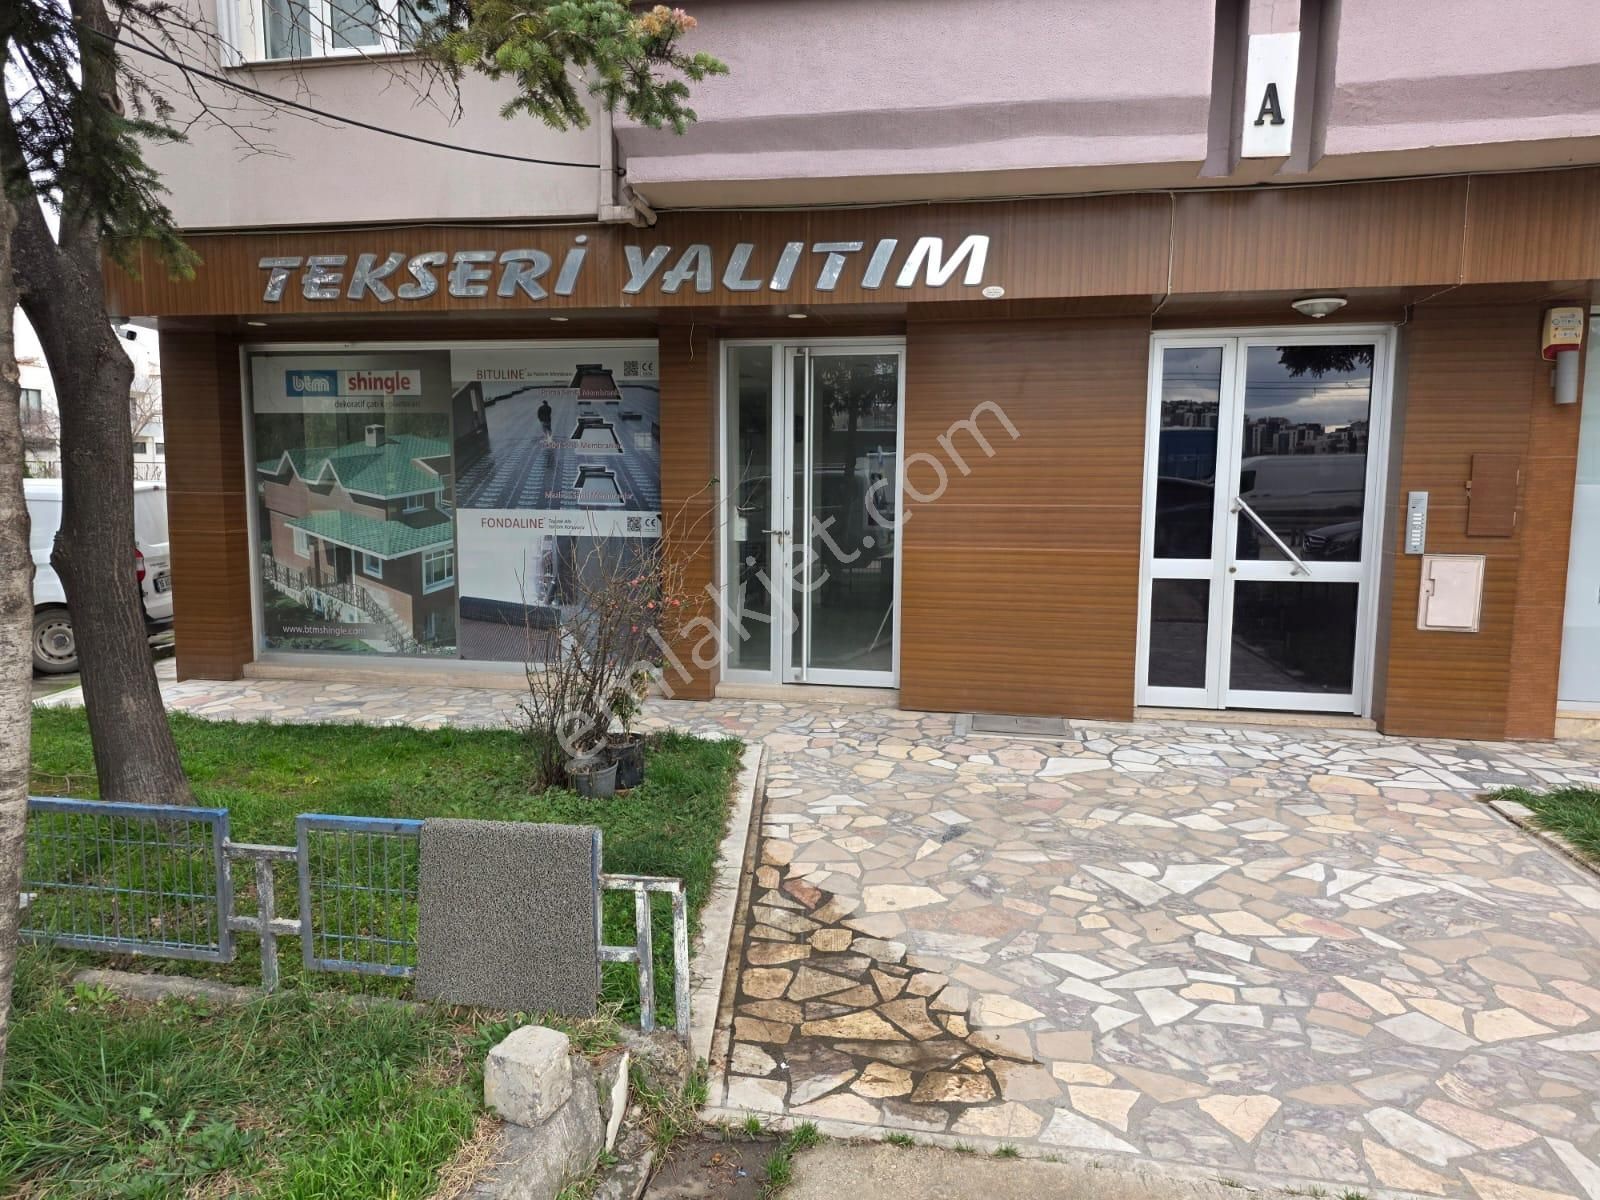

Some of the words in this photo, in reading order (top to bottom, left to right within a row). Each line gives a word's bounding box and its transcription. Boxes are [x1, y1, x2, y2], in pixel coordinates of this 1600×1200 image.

[1254, 82, 1285, 126] A
[258, 233, 590, 304] TEKSERİ
[622, 233, 991, 294] YALITIM
[476, 368, 525, 380] BITULINE
[292, 375, 330, 392] btm
[348, 371, 411, 394] shingle
[334, 399, 365, 408] dekoratif
[481, 517, 544, 529] FONDALINE
[282, 624, 367, 637] www.btmshingle.com
